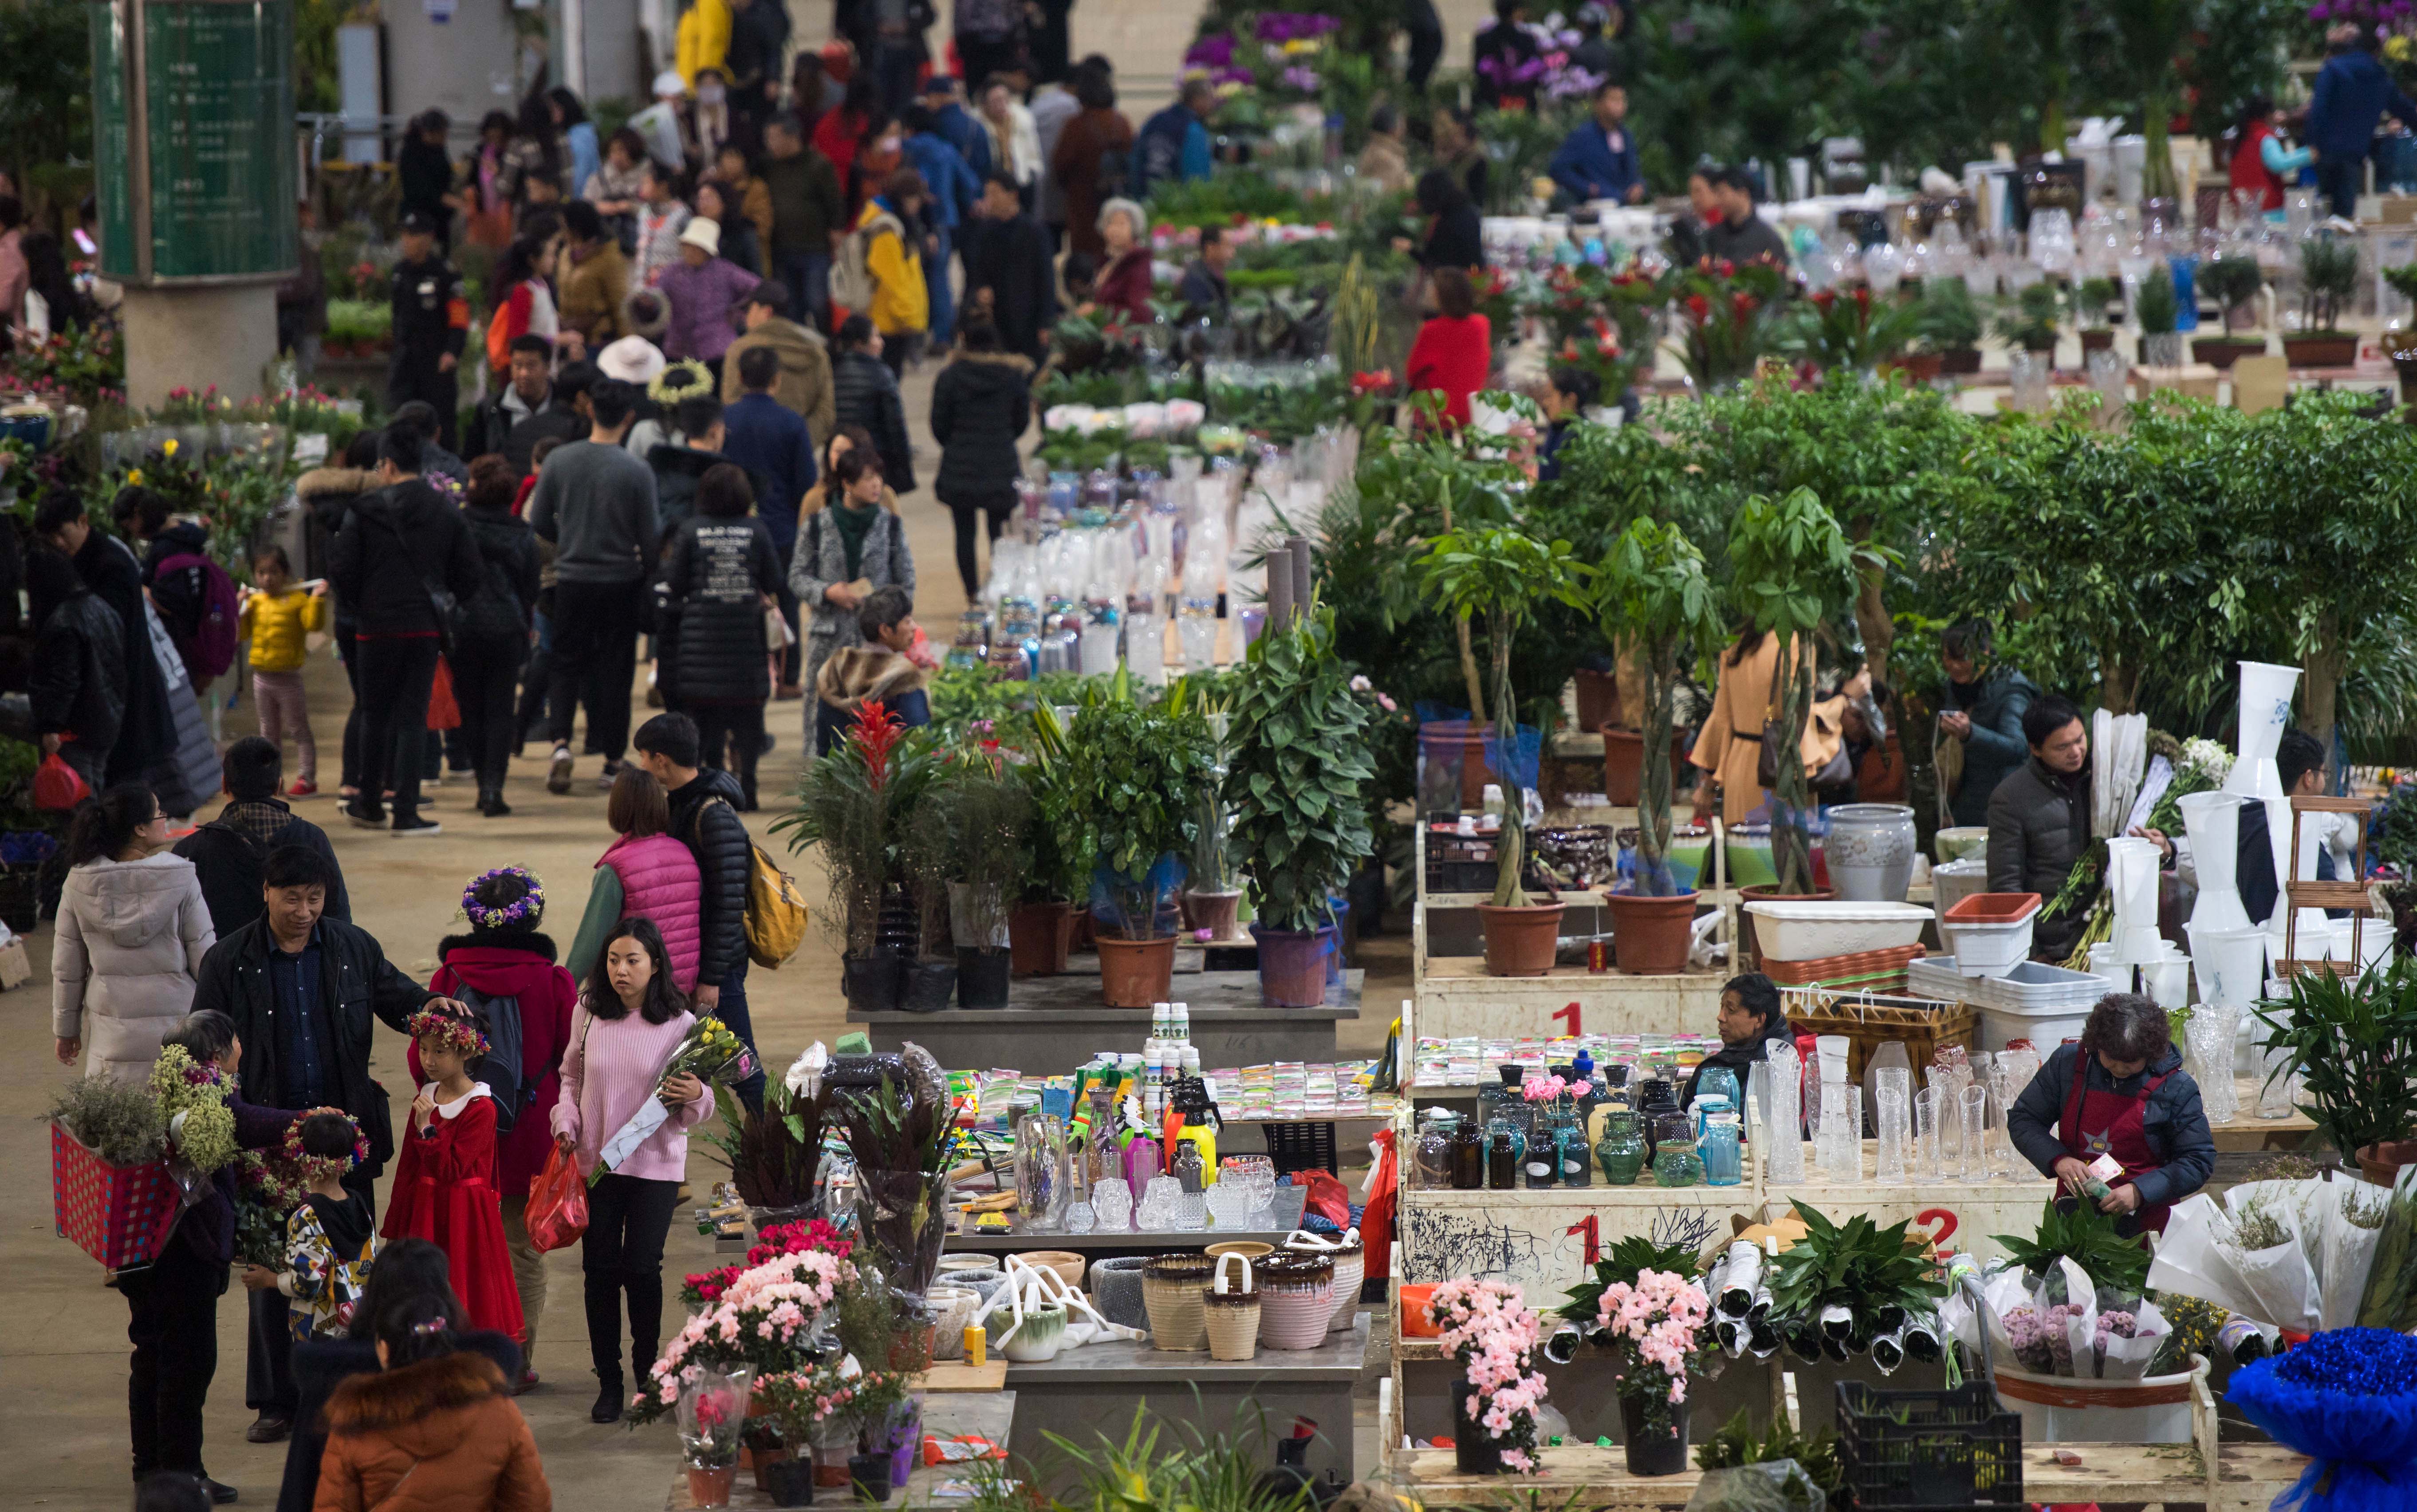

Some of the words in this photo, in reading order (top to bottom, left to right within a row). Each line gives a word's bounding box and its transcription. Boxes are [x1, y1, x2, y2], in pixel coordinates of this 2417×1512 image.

[1552, 1002, 1581, 1036] 1
[1567, 1215, 1599, 1264] 1
[1917, 1208, 1958, 1258] 2
[316, 1314, 338, 1333] SPEE
